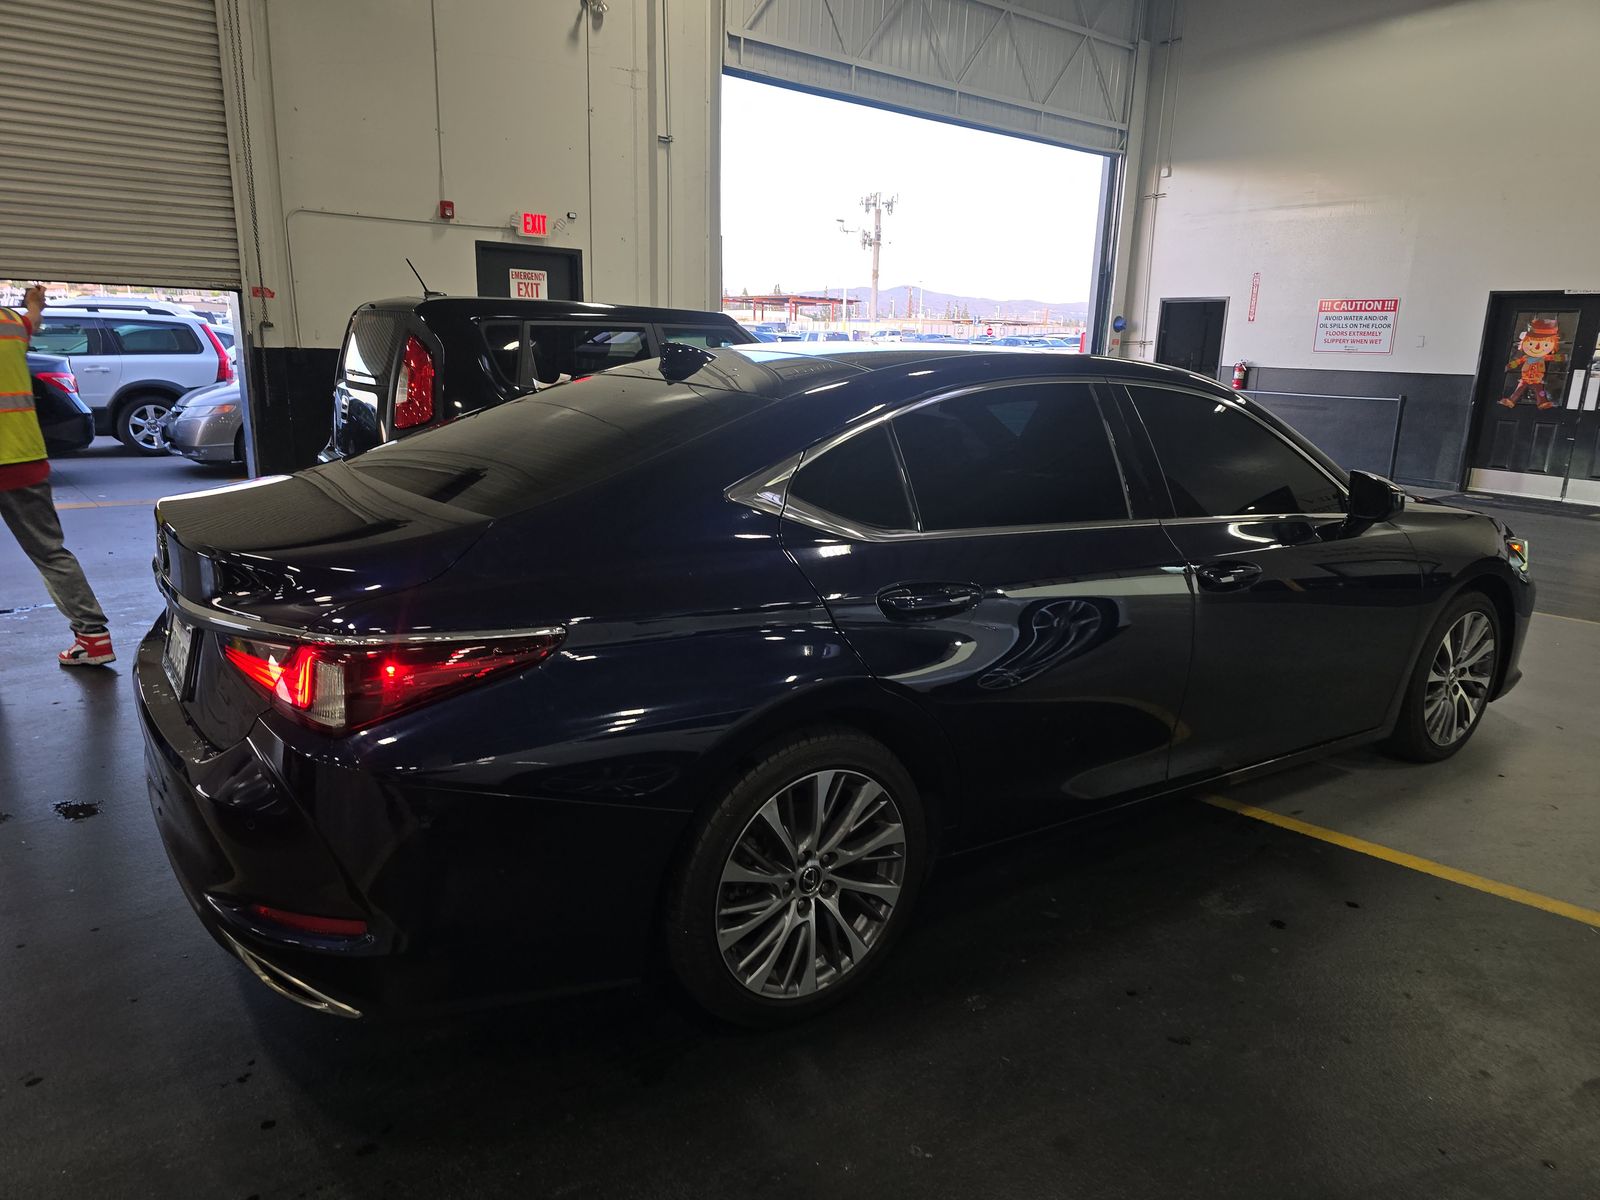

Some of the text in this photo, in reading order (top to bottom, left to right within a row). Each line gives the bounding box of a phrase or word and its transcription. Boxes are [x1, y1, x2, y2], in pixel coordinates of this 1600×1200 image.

[523, 213, 547, 235] EXIT
[511, 271, 545, 281] EMERGENCY
[517, 282, 540, 298] EXIT
[1333, 301, 1382, 311] CAUTION
